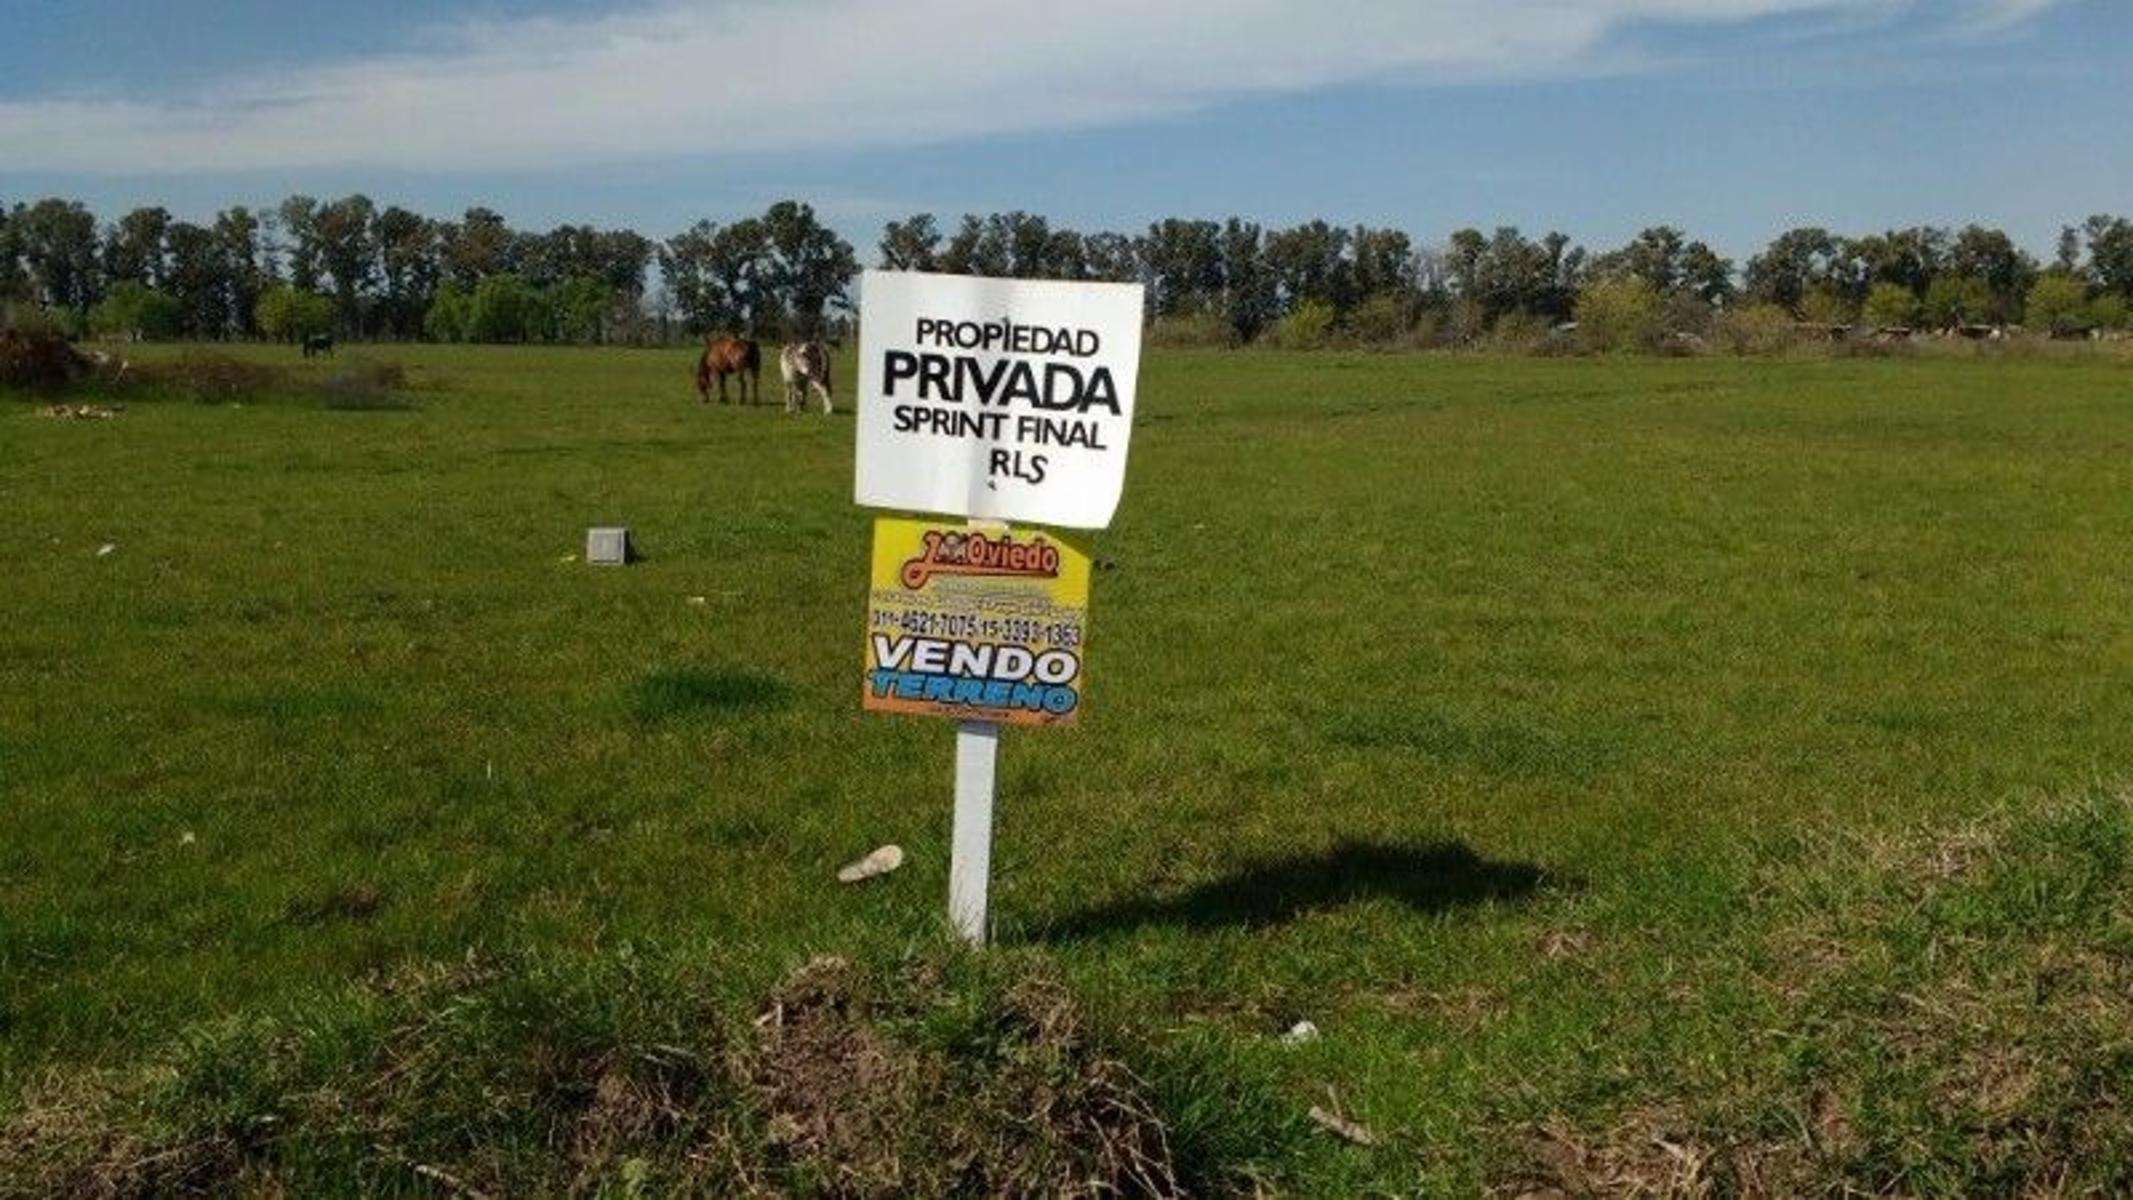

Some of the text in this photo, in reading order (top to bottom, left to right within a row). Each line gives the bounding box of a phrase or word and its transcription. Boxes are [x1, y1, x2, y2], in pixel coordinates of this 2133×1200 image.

[915, 317, 1100, 358] PROPIEDAD
[882, 349, 1123, 417] PRIVADA
[893, 404, 1108, 451] SPRINT FINAL
[988, 448, 1049, 485] RLS
[871, 632, 1080, 685] VENDO
[867, 666, 1079, 715] TERRENO
